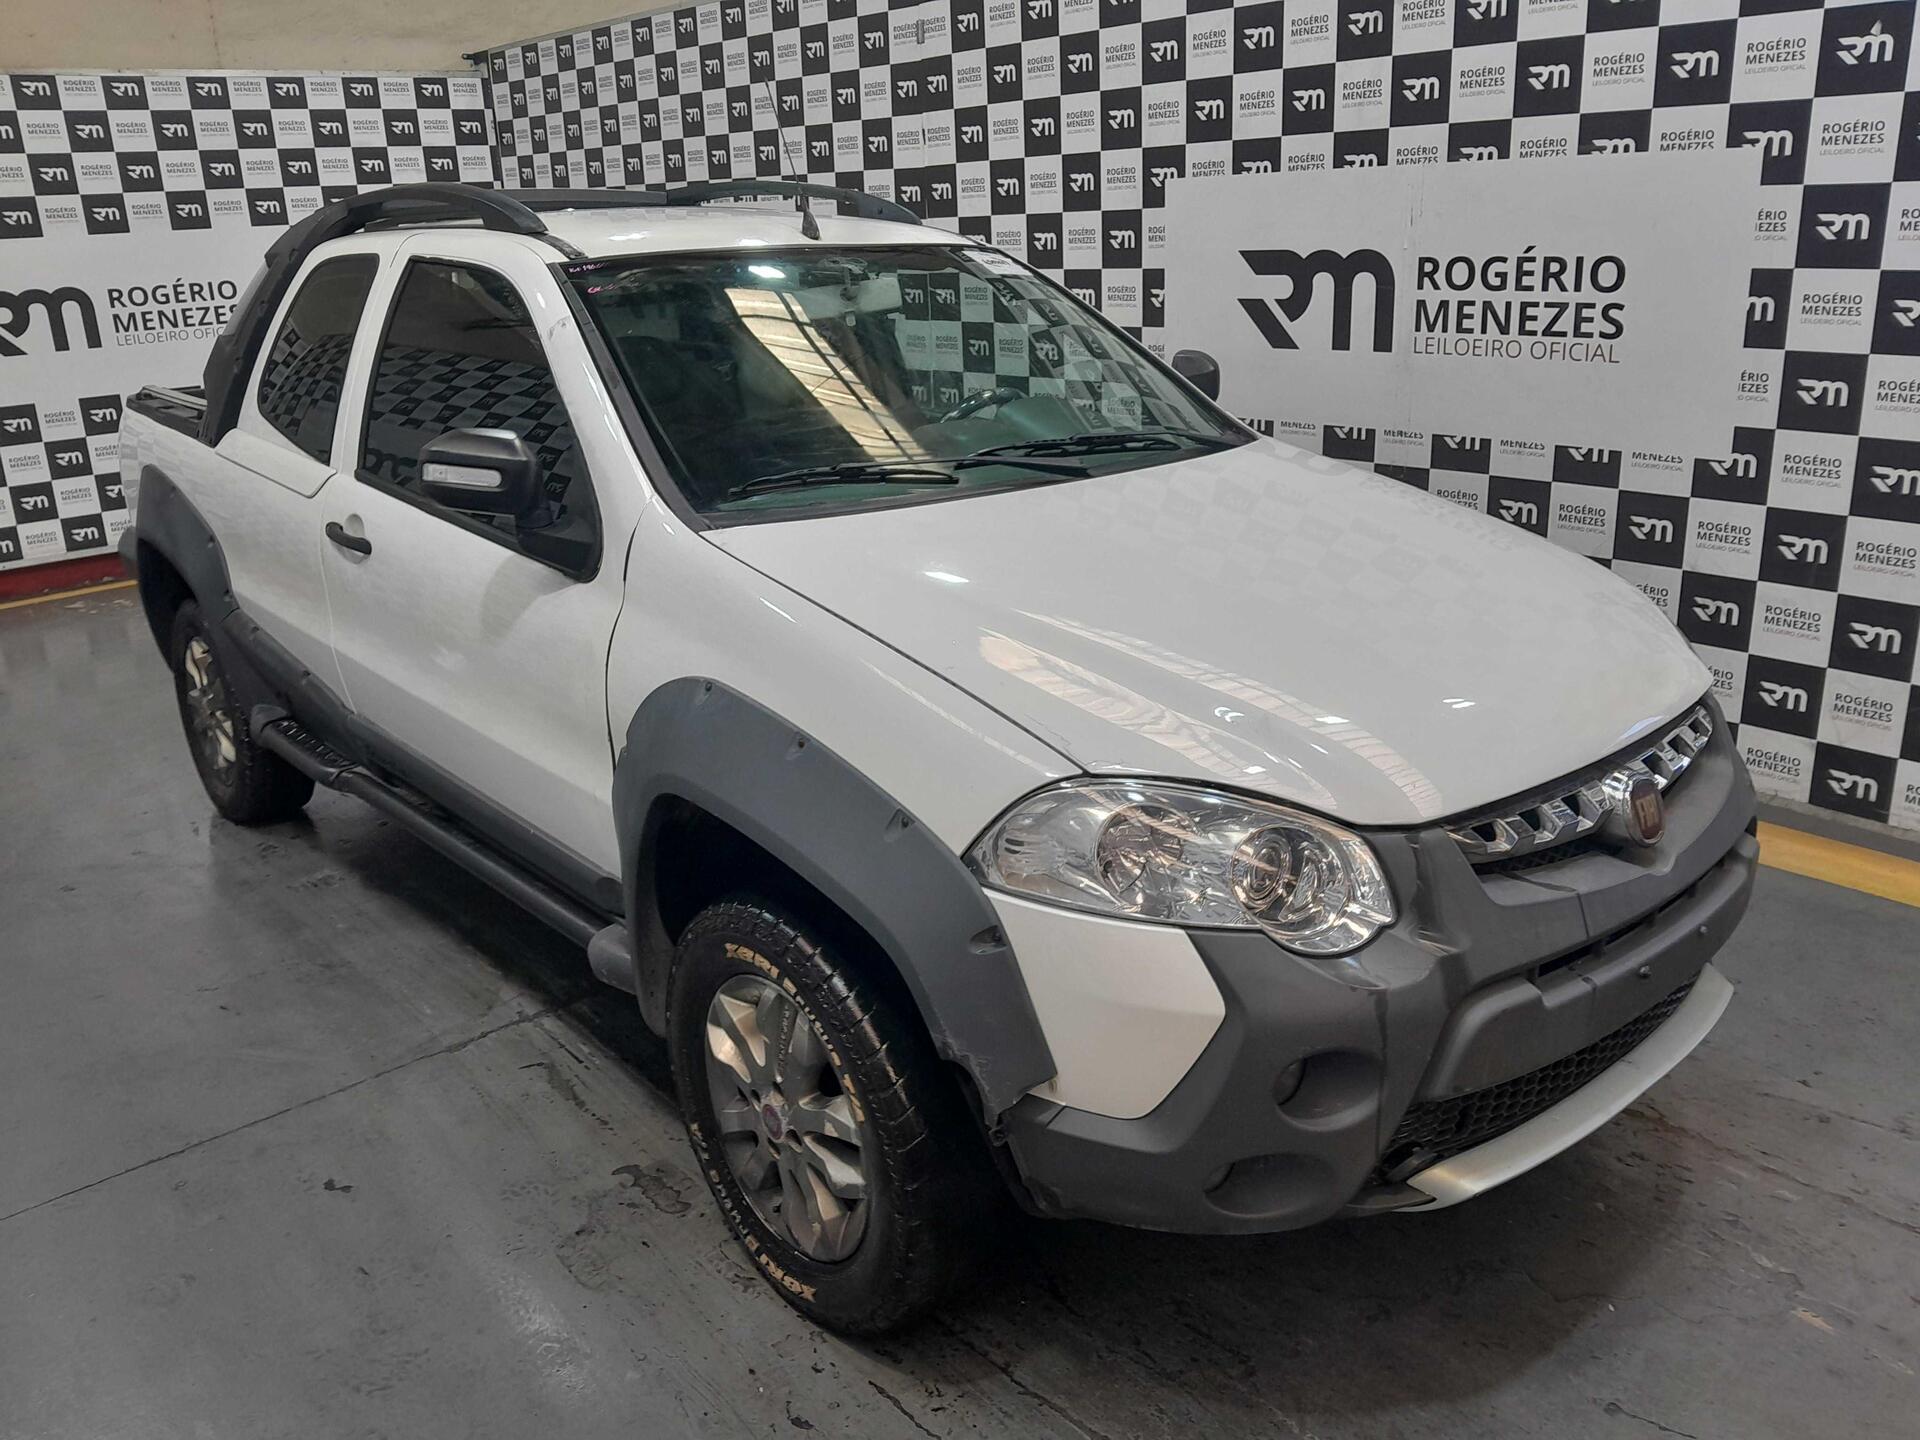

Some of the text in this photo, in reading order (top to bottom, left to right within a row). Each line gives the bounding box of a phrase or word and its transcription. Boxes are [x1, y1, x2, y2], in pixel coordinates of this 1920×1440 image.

[1290, 13, 1329, 27] ROGÉRIO
[1401, 7, 1445, 22] MENEZES
[1192, 28, 1226, 42] ROGÉRIO
[1290, 23, 1329, 37] MENEZES
[1192, 38, 1226, 51] MENEZES
[1746, 36, 1806, 53] ROGÉRIO
[1593, 51, 1645, 67] ROGÉRIO
[1745, 49, 1805, 65] MENEZES
[1459, 65, 1505, 79] ROGÉRIO
[1592, 63, 1644, 78] MENEZES
[1342, 78, 1382, 91] ROGÉRIO
[1459, 76, 1504, 89] MENEZES
[1239, 89, 1274, 101] ROGÉRIO
[1342, 88, 1382, 101] MENEZES
[1147, 100, 1179, 111] ROGÉRIO
[1239, 99, 1275, 111] MENEZES
[1147, 109, 1179, 120] MENEZES
[1821, 119, 1885, 134] ROGÉRIO
[1660, 128, 1715, 142] ROGÉRIO
[1820, 132, 1884, 146] MENEZES
[1519, 136, 1567, 149] ROGÉRIO
[1396, 144, 1438, 157] ROGÉRIO
[1191, 159, 1225, 170] ROGÉRIO
[1287, 152, 1325, 164] ROGÉRIO
[1417, 245, 1626, 293] ROGÉRIO
[107, 278, 238, 308] ROGÉRIO
[1802, 291, 1863, 305] ROGÉRIO
[1800, 305, 1862, 316] MENEZES
[1414, 299, 1625, 340] MENEZES
[117, 326, 224, 347] LEILOEIRO OFIC
[1413, 337, 1621, 363] LEILOEIRO OFICIAL
[1783, 453, 1842, 468] ROGÉRIO
[1782, 464, 1841, 479] MENEZES
[1436, 488, 1478, 501] ROGÉRIO
[1558, 503, 1606, 517] ROGÉRIO
[1558, 513, 1605, 527] MENEZES
[1697, 520, 1751, 536] ROGÉRIO
[1696, 530, 1750, 546] MENEZES
[1855, 541, 1917, 557] ROGÉRIO
[1854, 552, 1916, 569] MENEZES
[1764, 604, 1821, 622] ROGÉRIO
[1763, 615, 1820, 632] MENEZES
[1834, 692, 1893, 712] ROGÉRIO
[1832, 702, 1892, 723] MENEZES
[1746, 746, 1801, 766] ROGÉRIO
[1745, 756, 1800, 776] MENEZES
